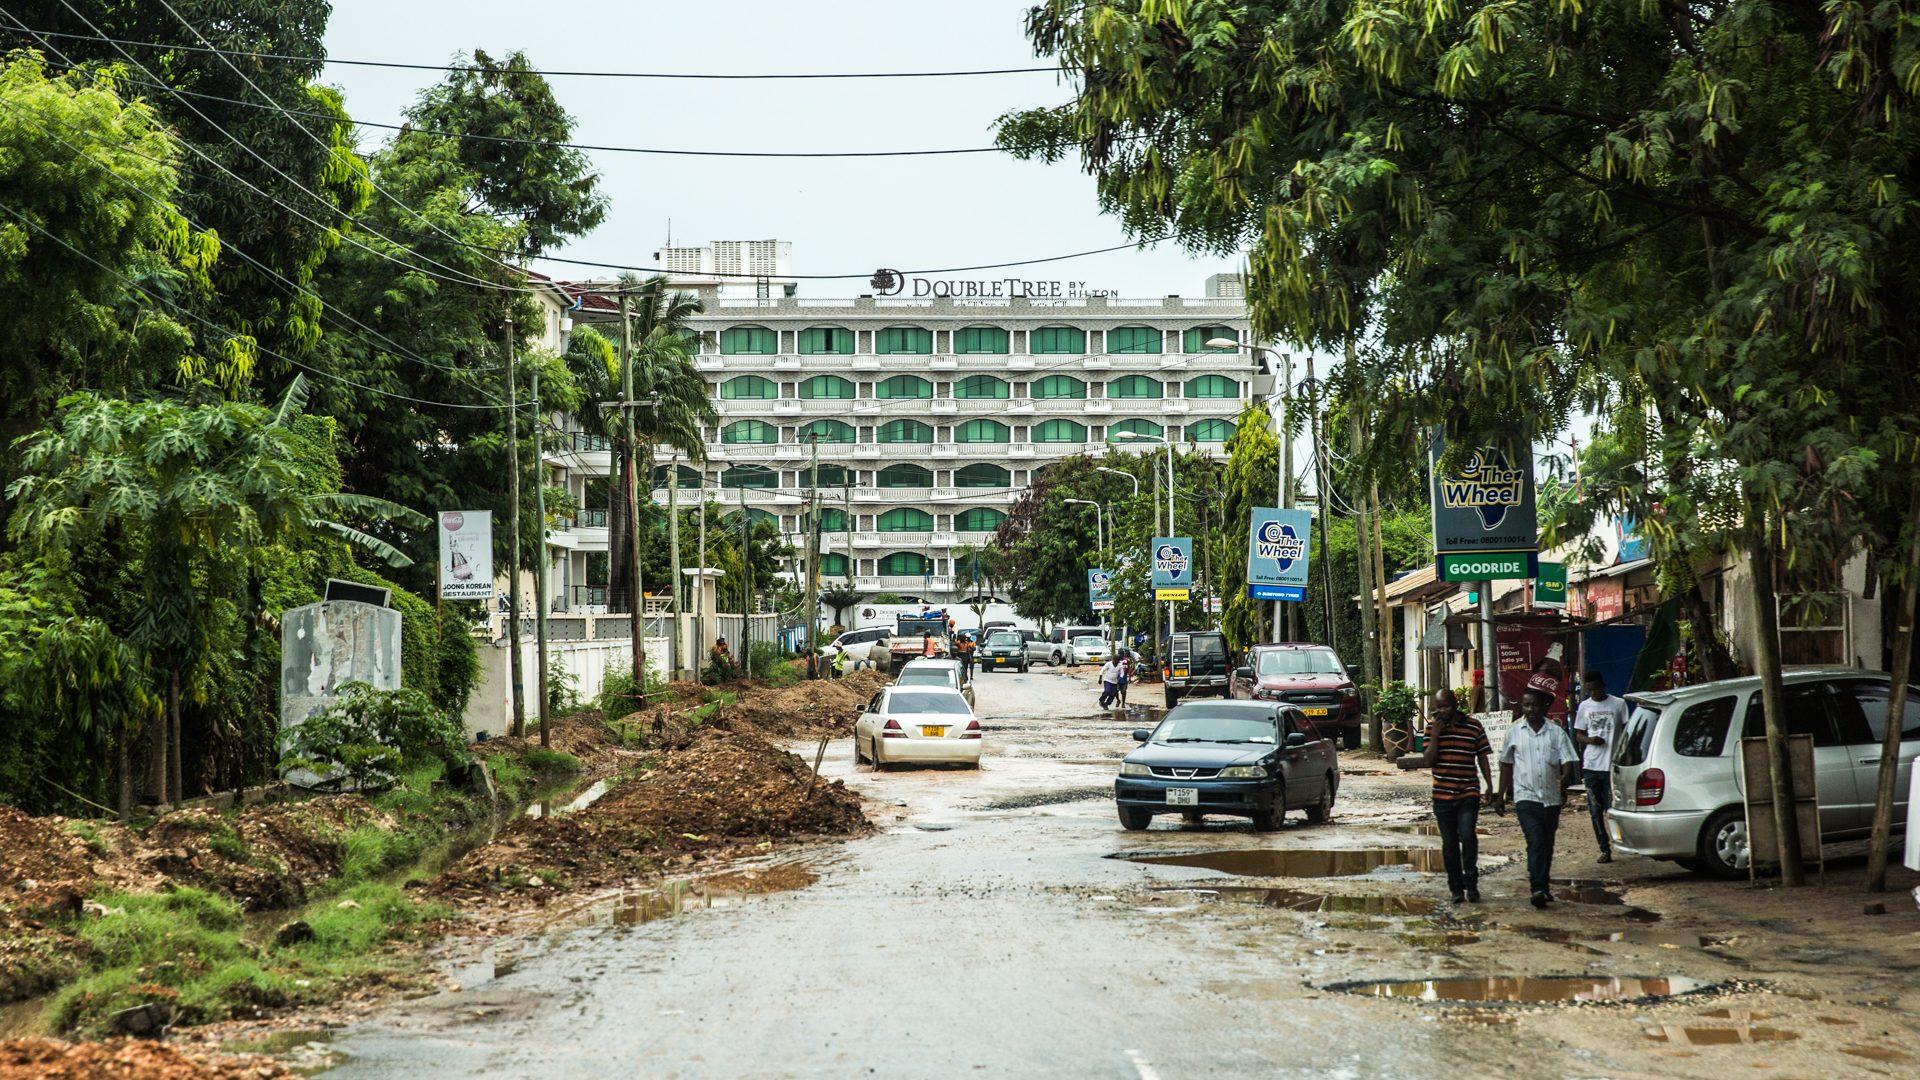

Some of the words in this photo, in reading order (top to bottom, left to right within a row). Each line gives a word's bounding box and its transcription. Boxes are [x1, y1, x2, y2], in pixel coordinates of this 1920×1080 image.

[1069, 281, 1086, 289] BY
[1069, 289, 1119, 298] HILTON
[1481, 467, 1513, 483] The
[1445, 482, 1520, 505] Wheel
[1280, 536, 1299, 546] The
[1259, 544, 1302, 558] Wheel
[1157, 561, 1187, 570] Wheel
[1449, 562, 1520, 575] GOODRIDE
